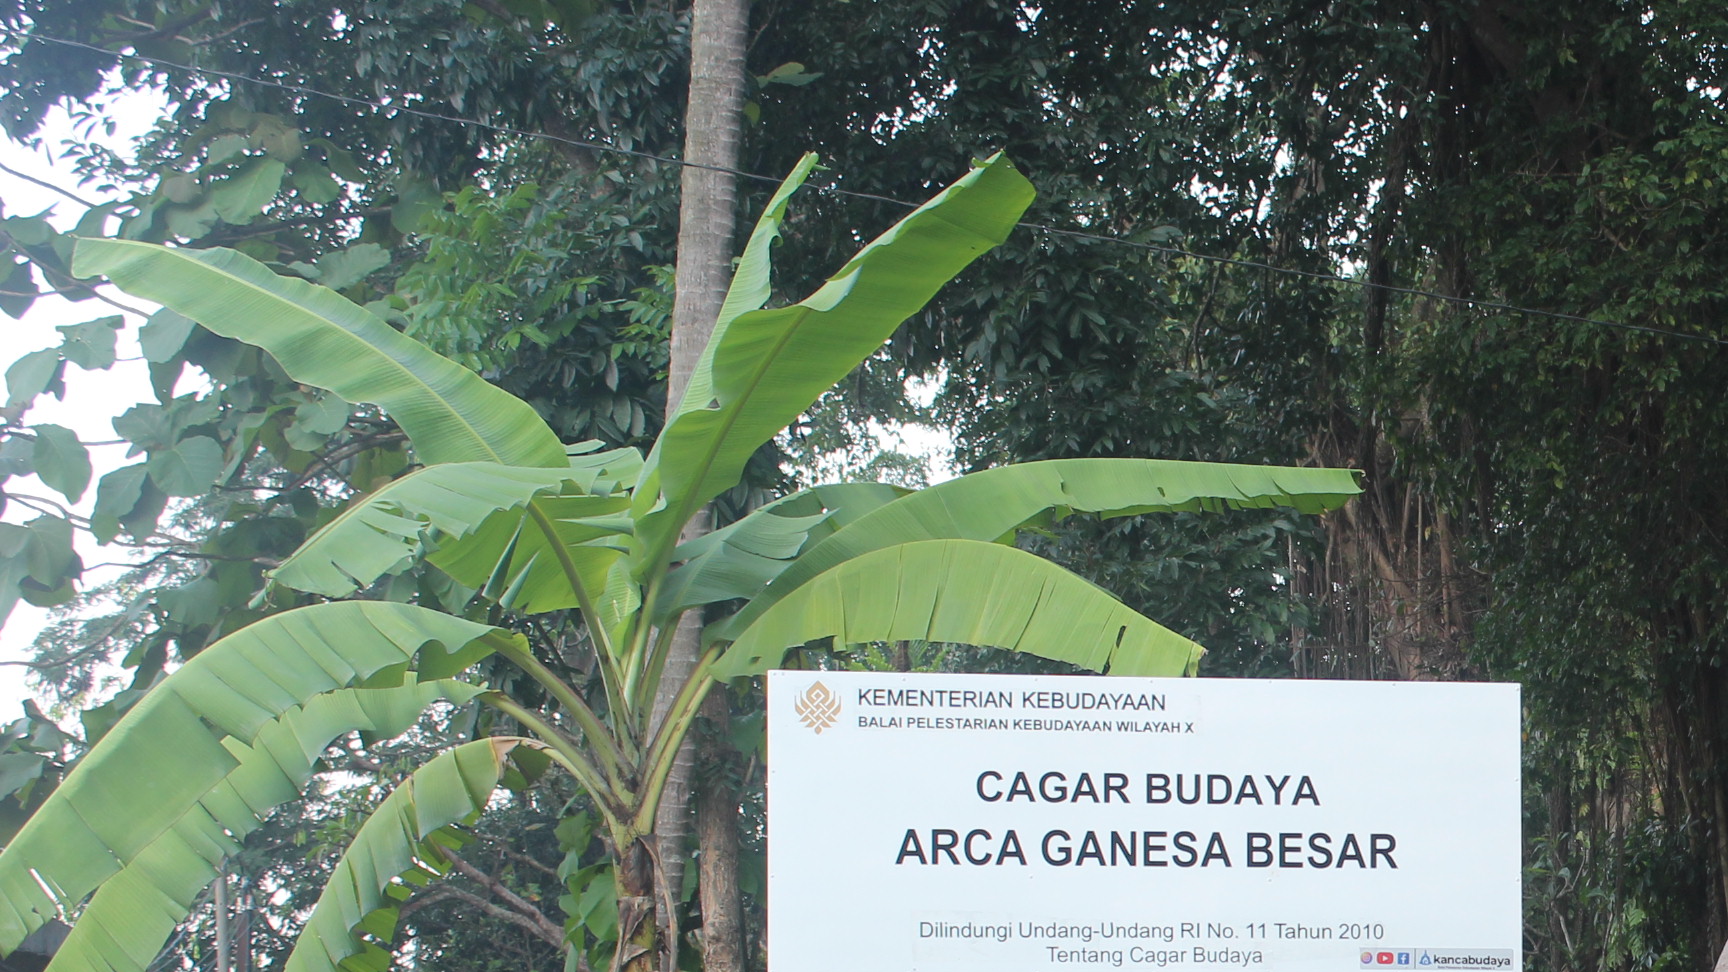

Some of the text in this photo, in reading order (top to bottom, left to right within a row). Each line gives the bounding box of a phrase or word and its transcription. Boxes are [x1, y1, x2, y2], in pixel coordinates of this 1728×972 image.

[857, 687, 1166, 712] KEMENTERIAN KEBUDAYAAN
[857, 715, 1194, 734] BALAI PELESTARIAN KEBUDAYAAN WILAYAH X
[975, 770, 1321, 807] CAGAR BUDAYA
[894, 828, 1399, 870] ARCA GANESA BESAR
[919, 921, 1384, 943] Dilindungi Undang-Undang RI No. 11 Tahun 2010
[1045, 945, 1263, 968] Tentang Cagar Budaya
[1433, 954, 1511, 968] kancabudaya
